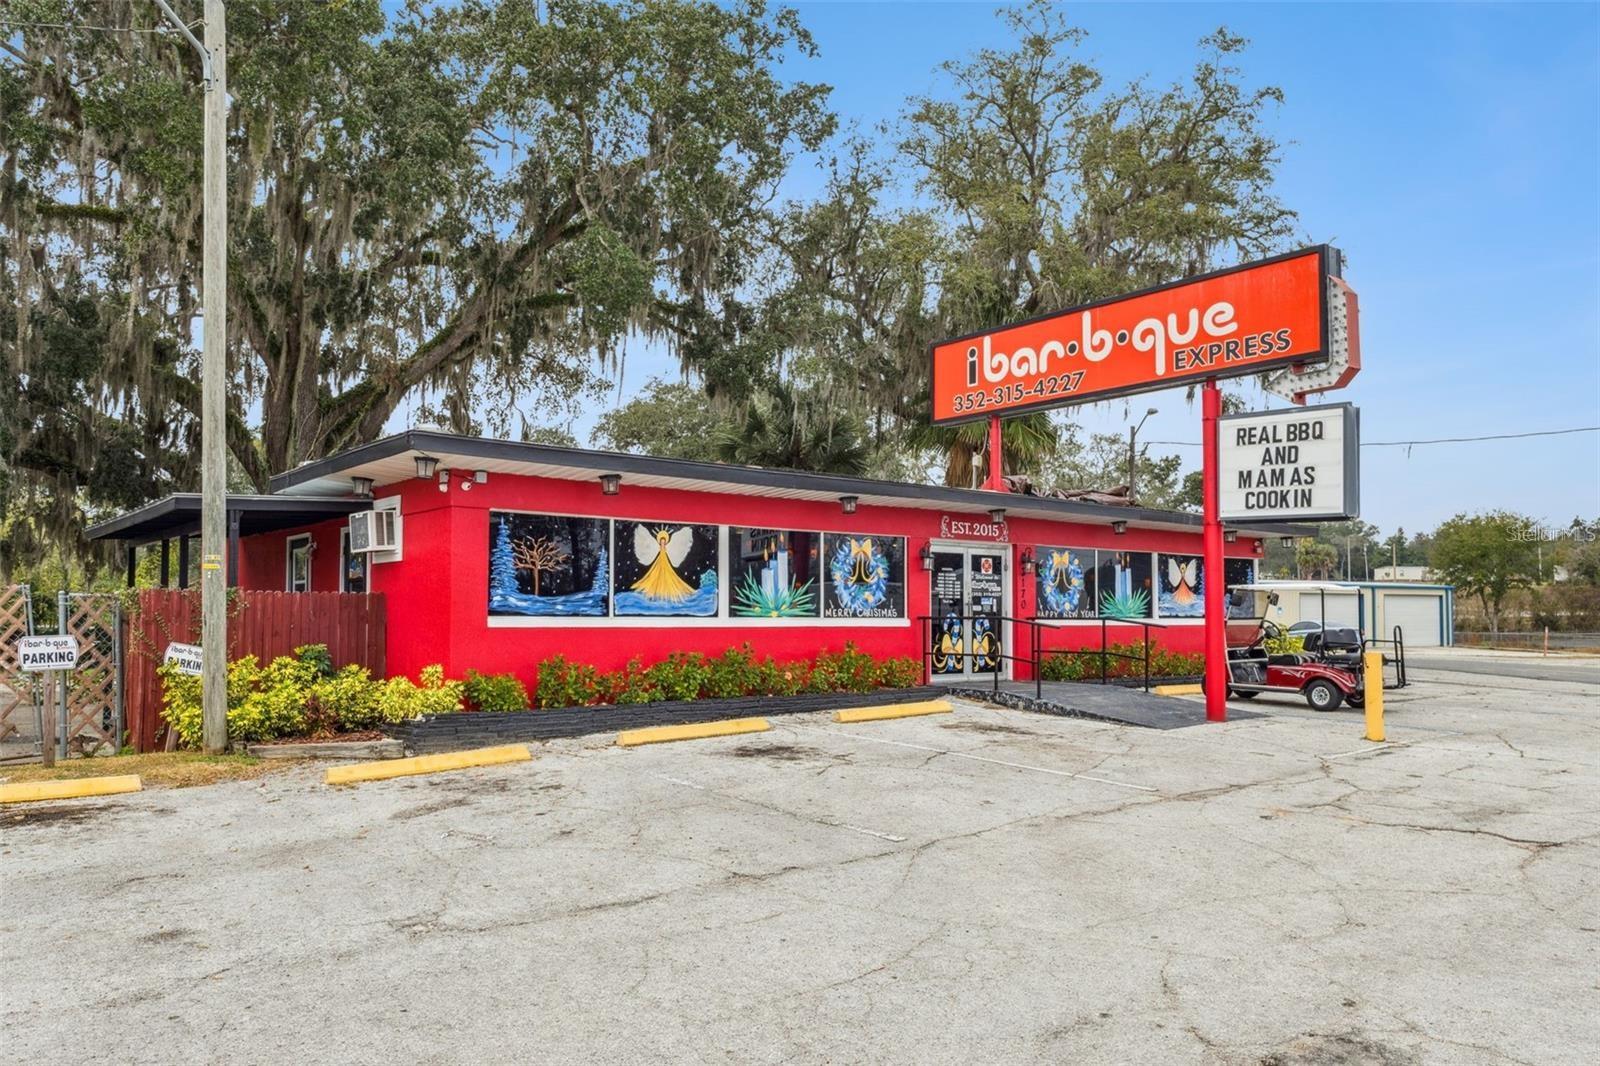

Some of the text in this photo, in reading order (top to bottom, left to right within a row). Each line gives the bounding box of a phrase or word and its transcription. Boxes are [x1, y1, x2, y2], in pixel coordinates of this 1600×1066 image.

[1173, 328, 1292, 372] EXPRESS
[954, 370, 1087, 412] 352-315-4227
[1236, 421, 1324, 446] REAL BBQ
[1261, 445, 1299, 466] AND
[1238, 466, 1315, 489] MAMAS
[1245, 489, 1312, 509] COOKIN
[951, 521, 999, 536] EST. 2015
[825, 608, 854, 617] MERRY
[1037, 610, 1059, 618] HAPPY
[22, 651, 75, 665] PARKING
